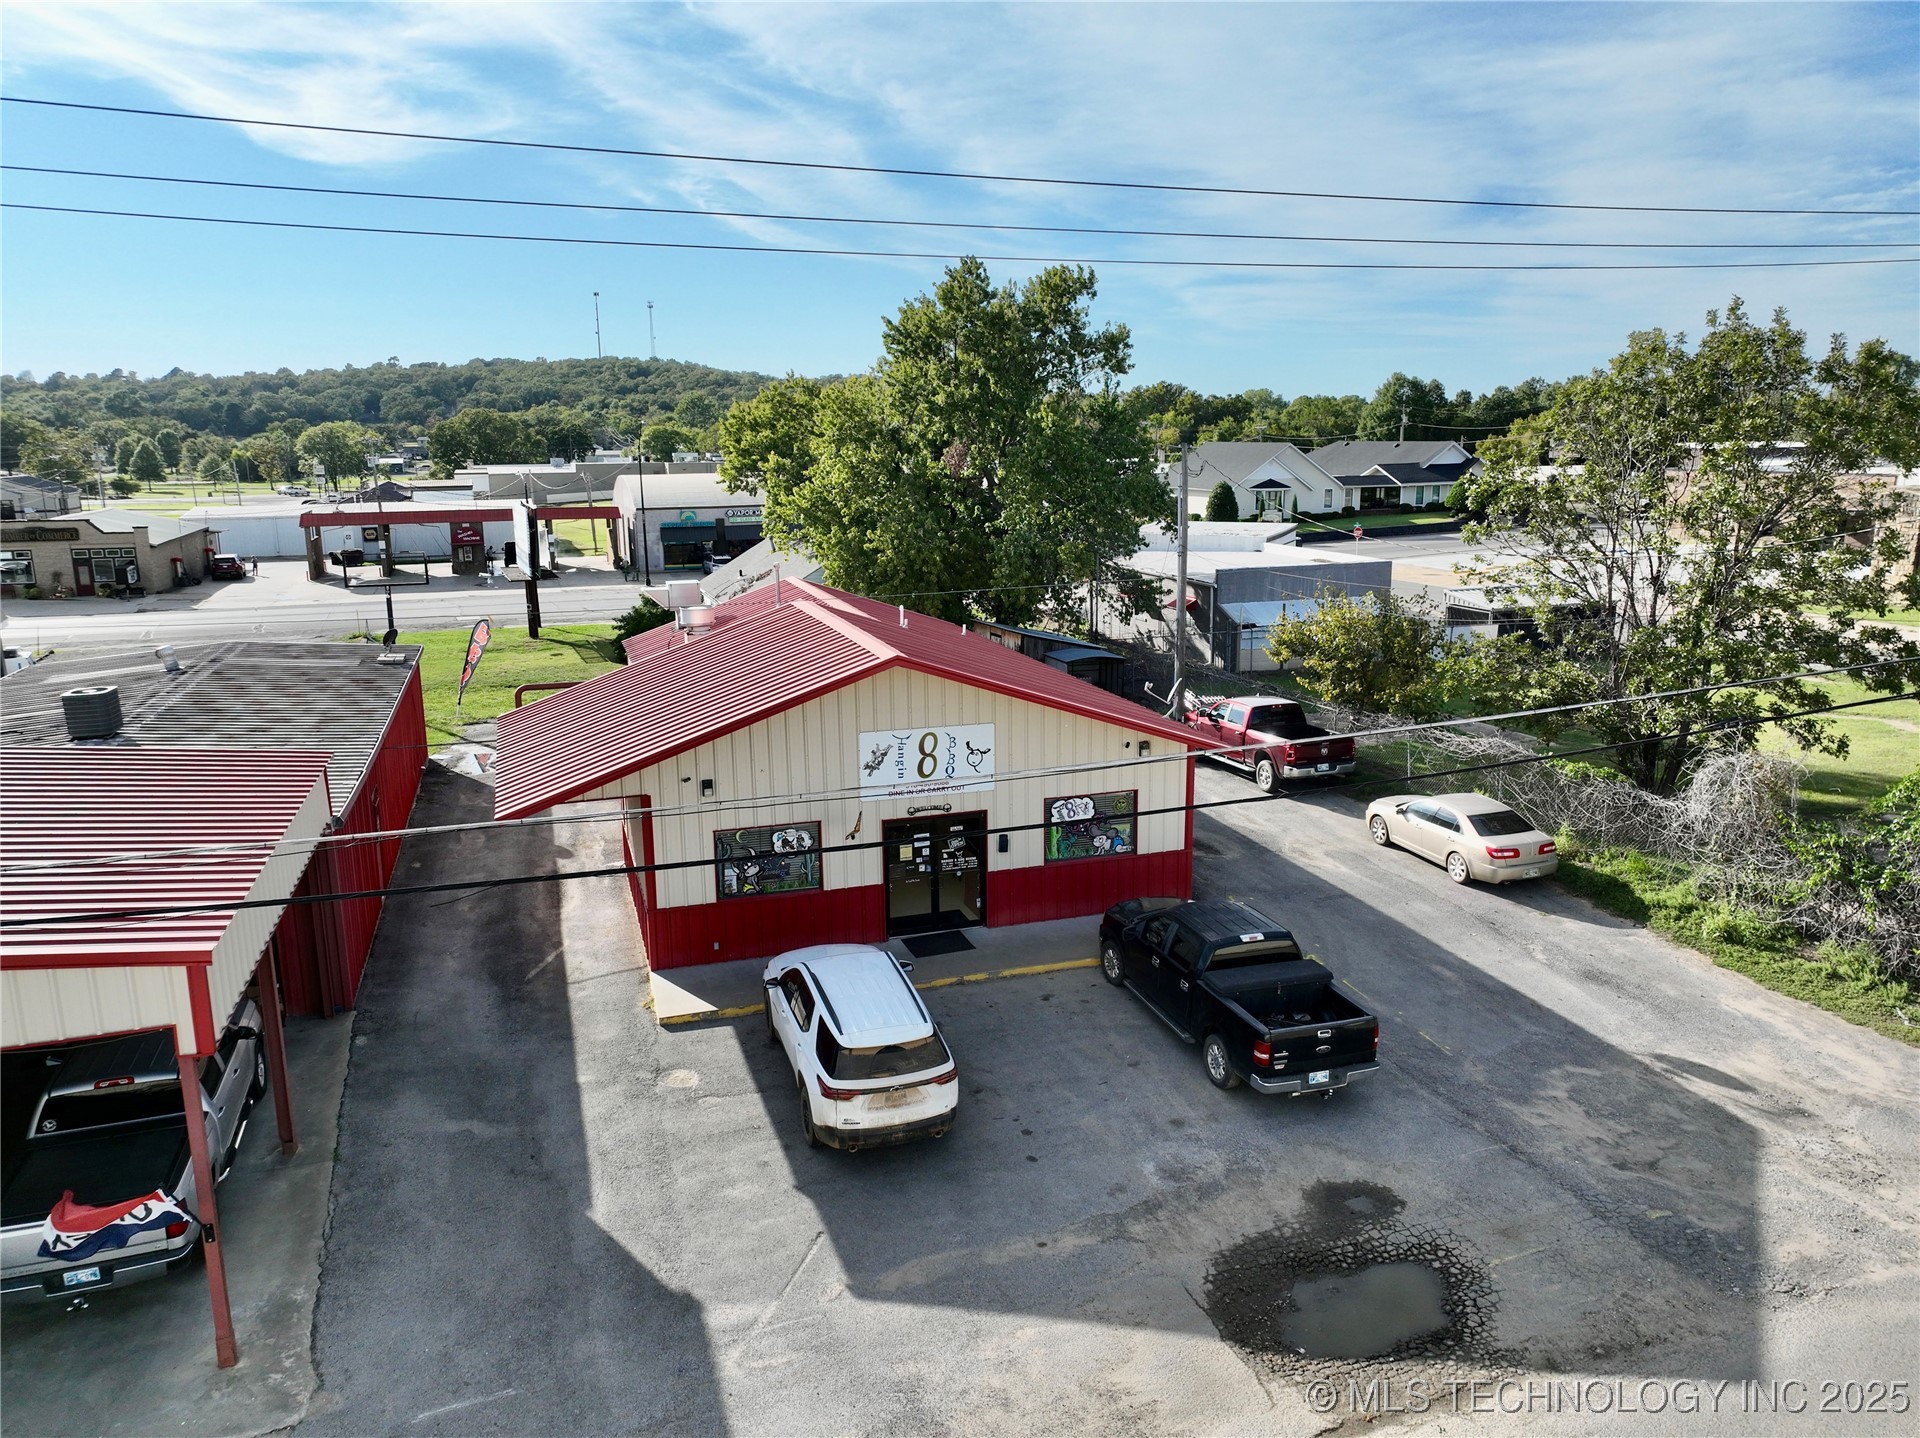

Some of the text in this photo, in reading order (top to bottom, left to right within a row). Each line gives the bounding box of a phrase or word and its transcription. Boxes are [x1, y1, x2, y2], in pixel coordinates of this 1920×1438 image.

[891, 733, 913, 779] Hangin
[917, 732, 938, 779] 8
[944, 732, 957, 779] BBQ
[926, 786, 949, 794] CARRY
